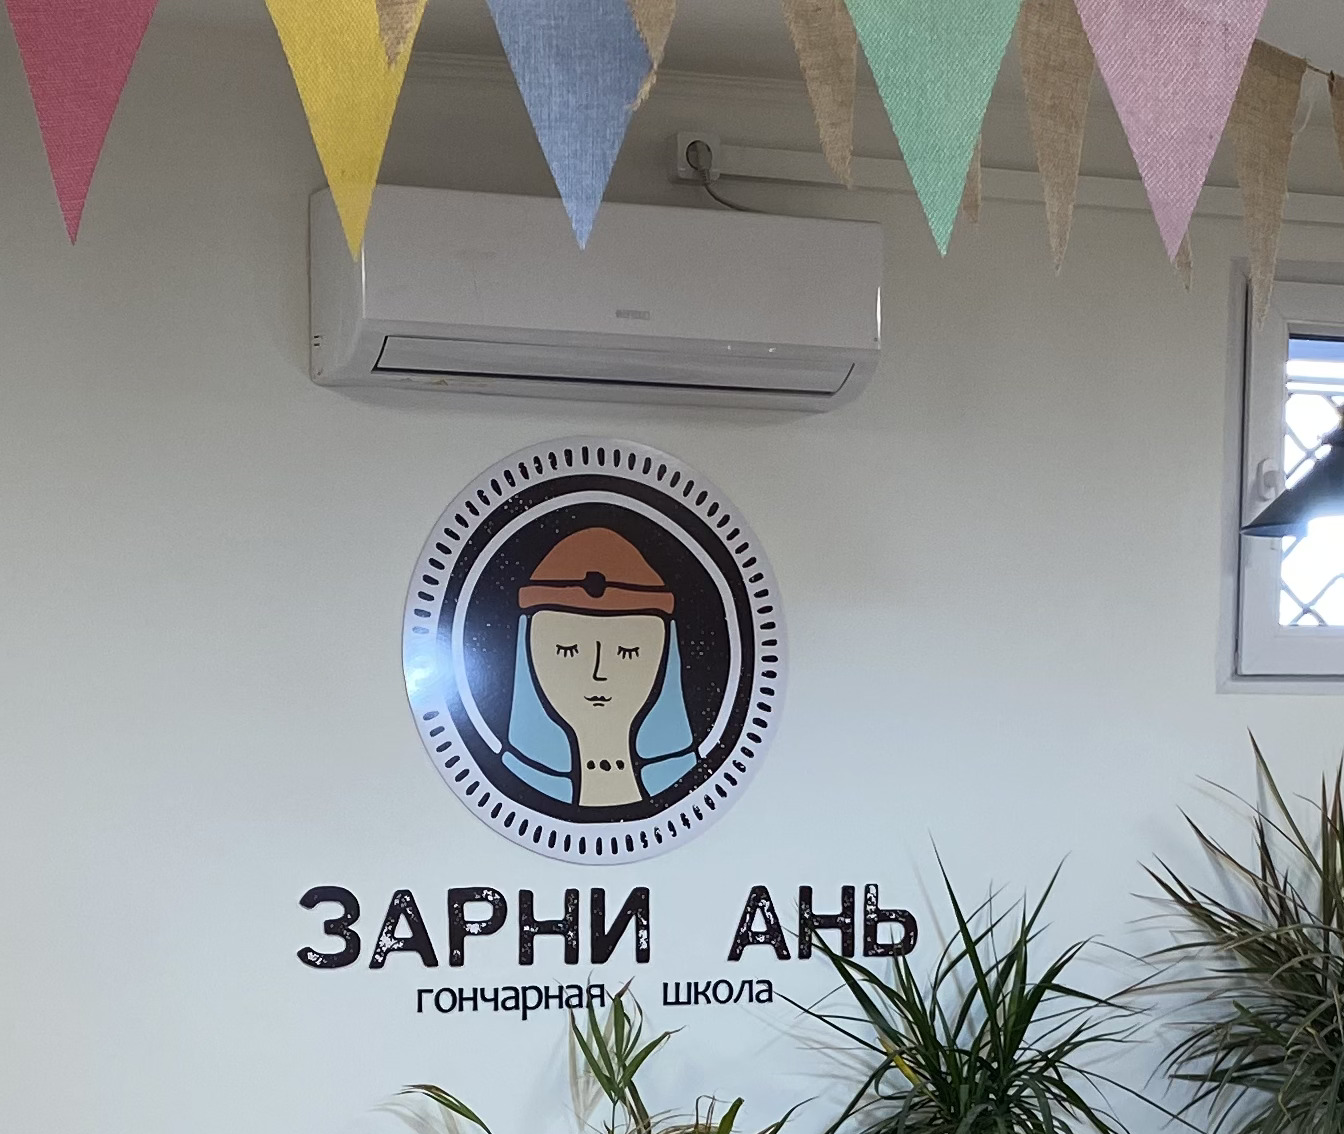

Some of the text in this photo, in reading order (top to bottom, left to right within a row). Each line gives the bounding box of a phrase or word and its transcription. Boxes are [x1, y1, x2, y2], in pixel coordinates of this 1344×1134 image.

[297, 883, 918, 970] ЗАРНИ АНЬ
[416, 978, 773, 1021] гончарная школа
